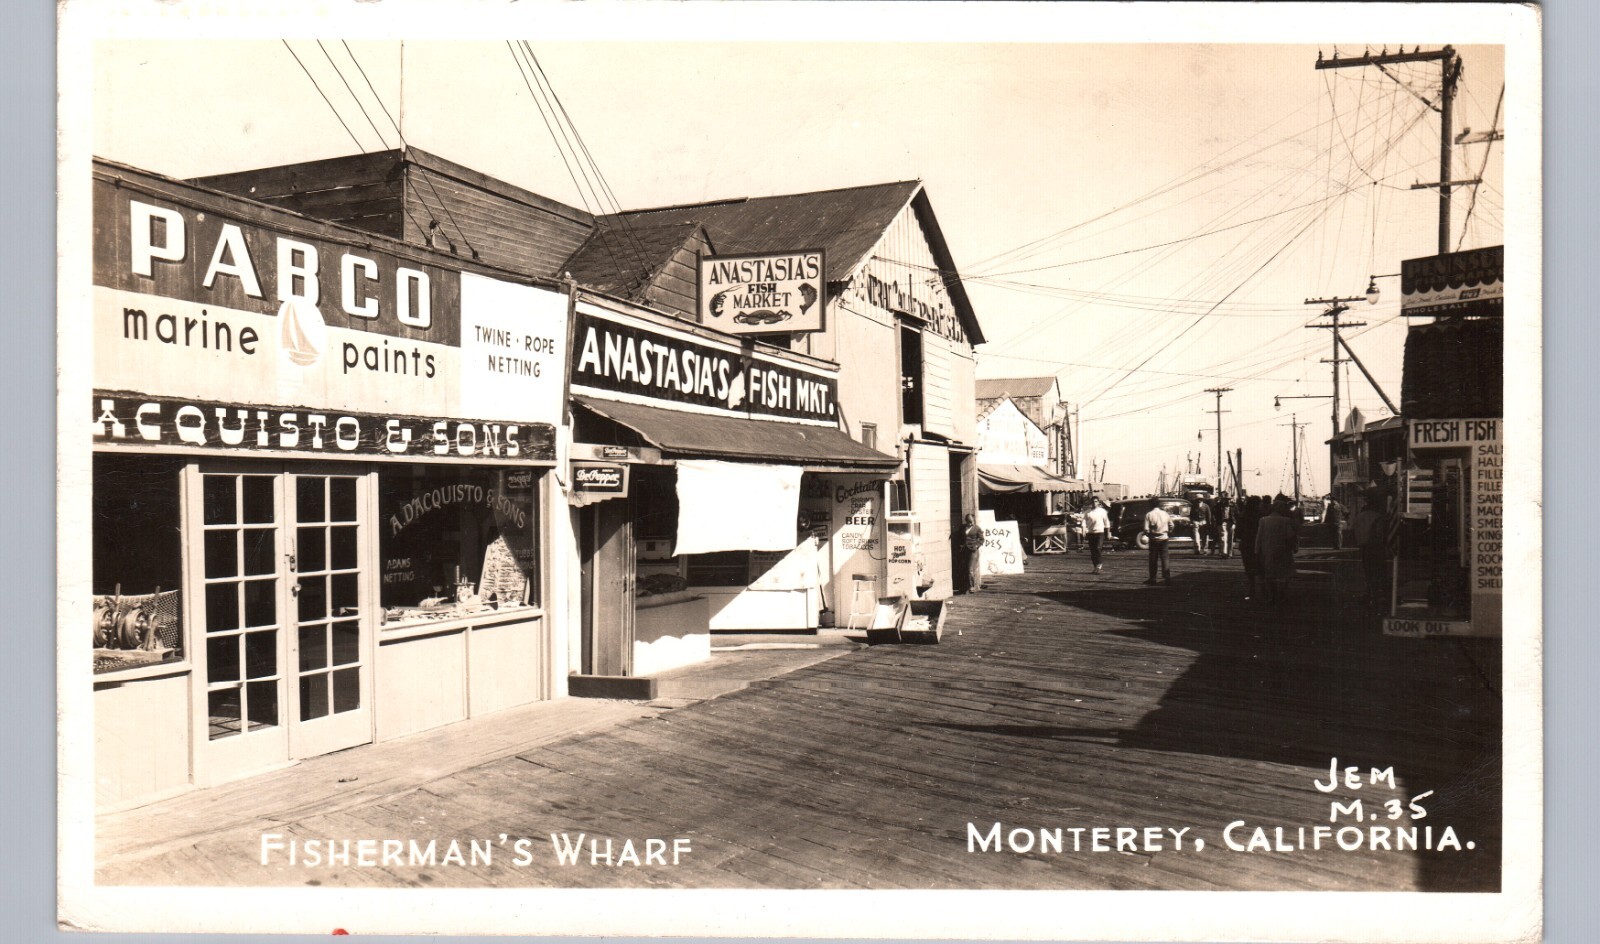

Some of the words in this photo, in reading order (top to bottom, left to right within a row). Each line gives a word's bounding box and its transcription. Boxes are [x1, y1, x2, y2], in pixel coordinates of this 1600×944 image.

[129, 200, 432, 329] PABCO
[709, 256, 819, 285] ANASTASIA'S
[733, 292, 792, 309] MARKET
[747, 283, 777, 294] FISH
[123, 306, 260, 355] marine
[342, 341, 436, 380] paints
[475, 325, 512, 347] TWINE
[525, 335, 555, 355] ROPE
[488, 354, 541, 379] NETTING
[578, 326, 730, 401] ANASTASIA'S
[750, 367, 791, 410] FISH
[796, 377, 834, 415] MKT.
[385, 419, 411, 453] &
[433, 422, 520, 457] SONS
[1414, 420, 1459, 444] FRESH
[1465, 420, 1497, 441] FISH
[1478, 445, 1502, 456] SAL
[390, 513, 406, 535] A.
[402, 484, 483, 521] D'ACQUISTO
[496, 494, 526, 529] SONS
[845, 516, 875, 525] BEER
[985, 528, 1011, 537] BOAT
[387, 558, 411, 570] ADAMS
[384, 571, 415, 584] NETTING
[1388, 620, 1419, 632] LOOK
